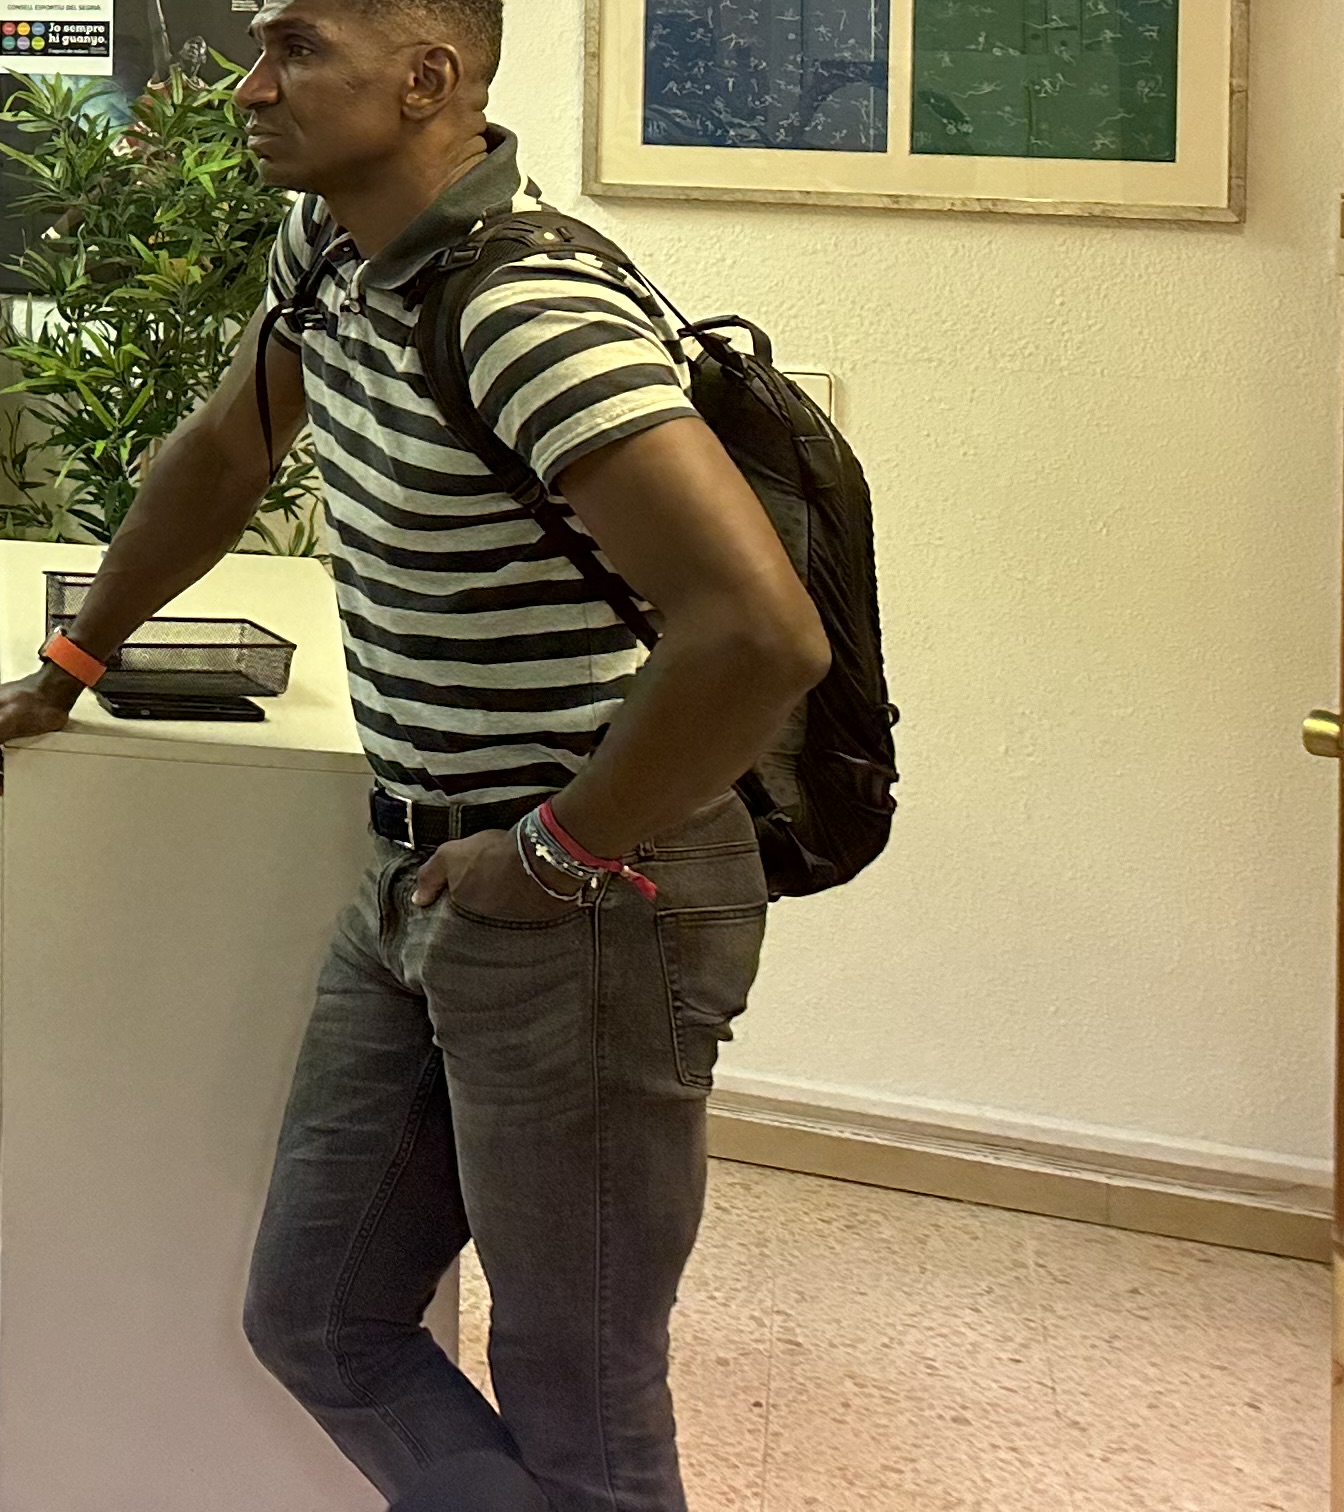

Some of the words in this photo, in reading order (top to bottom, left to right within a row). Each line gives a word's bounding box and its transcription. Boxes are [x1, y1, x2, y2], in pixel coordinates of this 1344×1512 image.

[48, 22, 61, 33] Jo
[63, 24, 105, 35] sempre
[48, 33, 60, 43] hi
